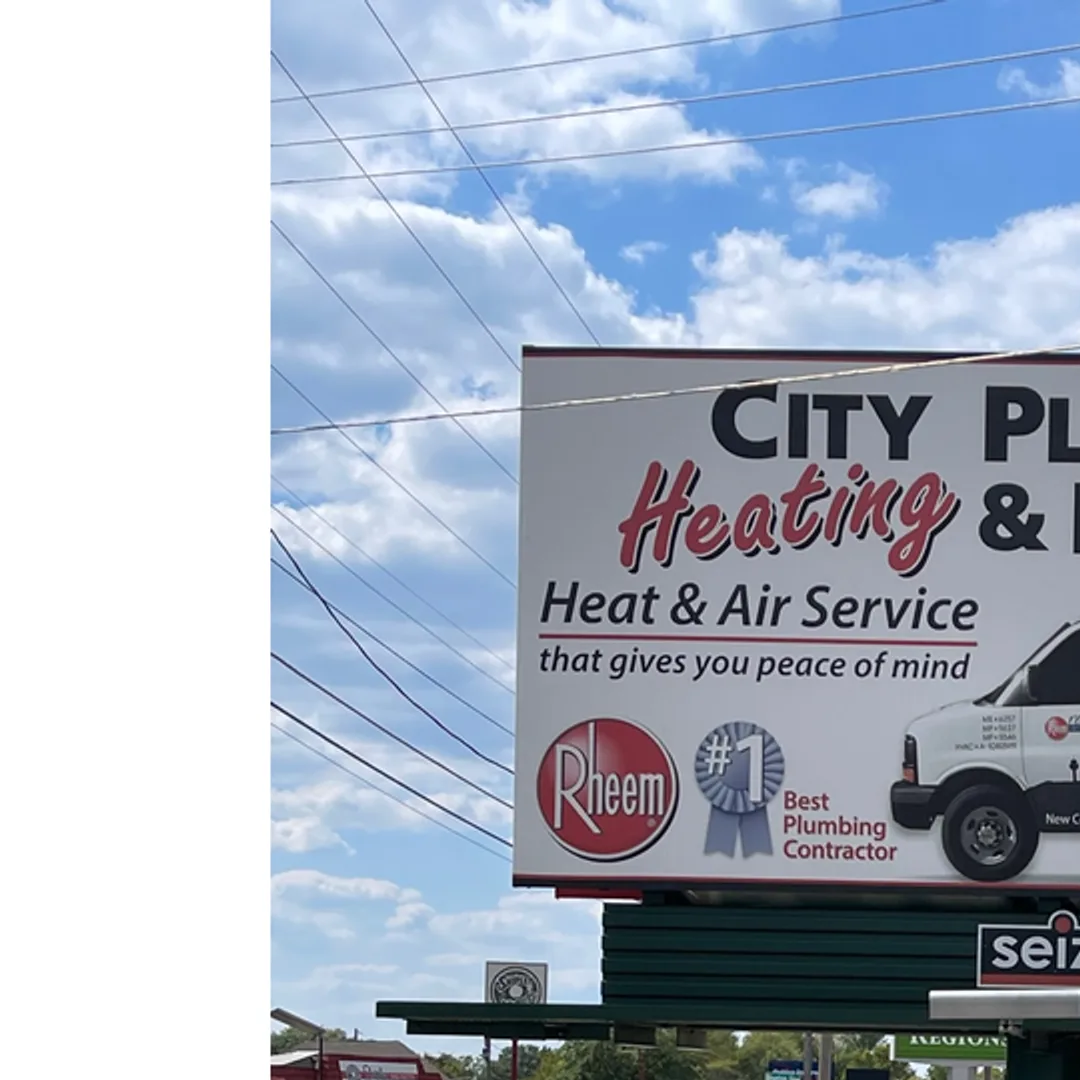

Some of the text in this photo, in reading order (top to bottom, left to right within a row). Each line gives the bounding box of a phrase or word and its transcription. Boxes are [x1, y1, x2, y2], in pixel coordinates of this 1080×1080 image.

[711, 380, 932, 460] CITY
[619, 459, 960, 577] Heating
[979, 482, 1049, 551] &
[540, 581, 979, 631] Heat & Air Service
[540, 646, 971, 682] that gives you peace of mind
[553, 721, 666, 833] Rheem
[704, 734, 763, 802] #1
[784, 792, 829, 811] Best
[1046, 813, 1070, 825] New
[784, 817, 886, 840] Plumbing
[784, 840, 898, 861] Contractor
